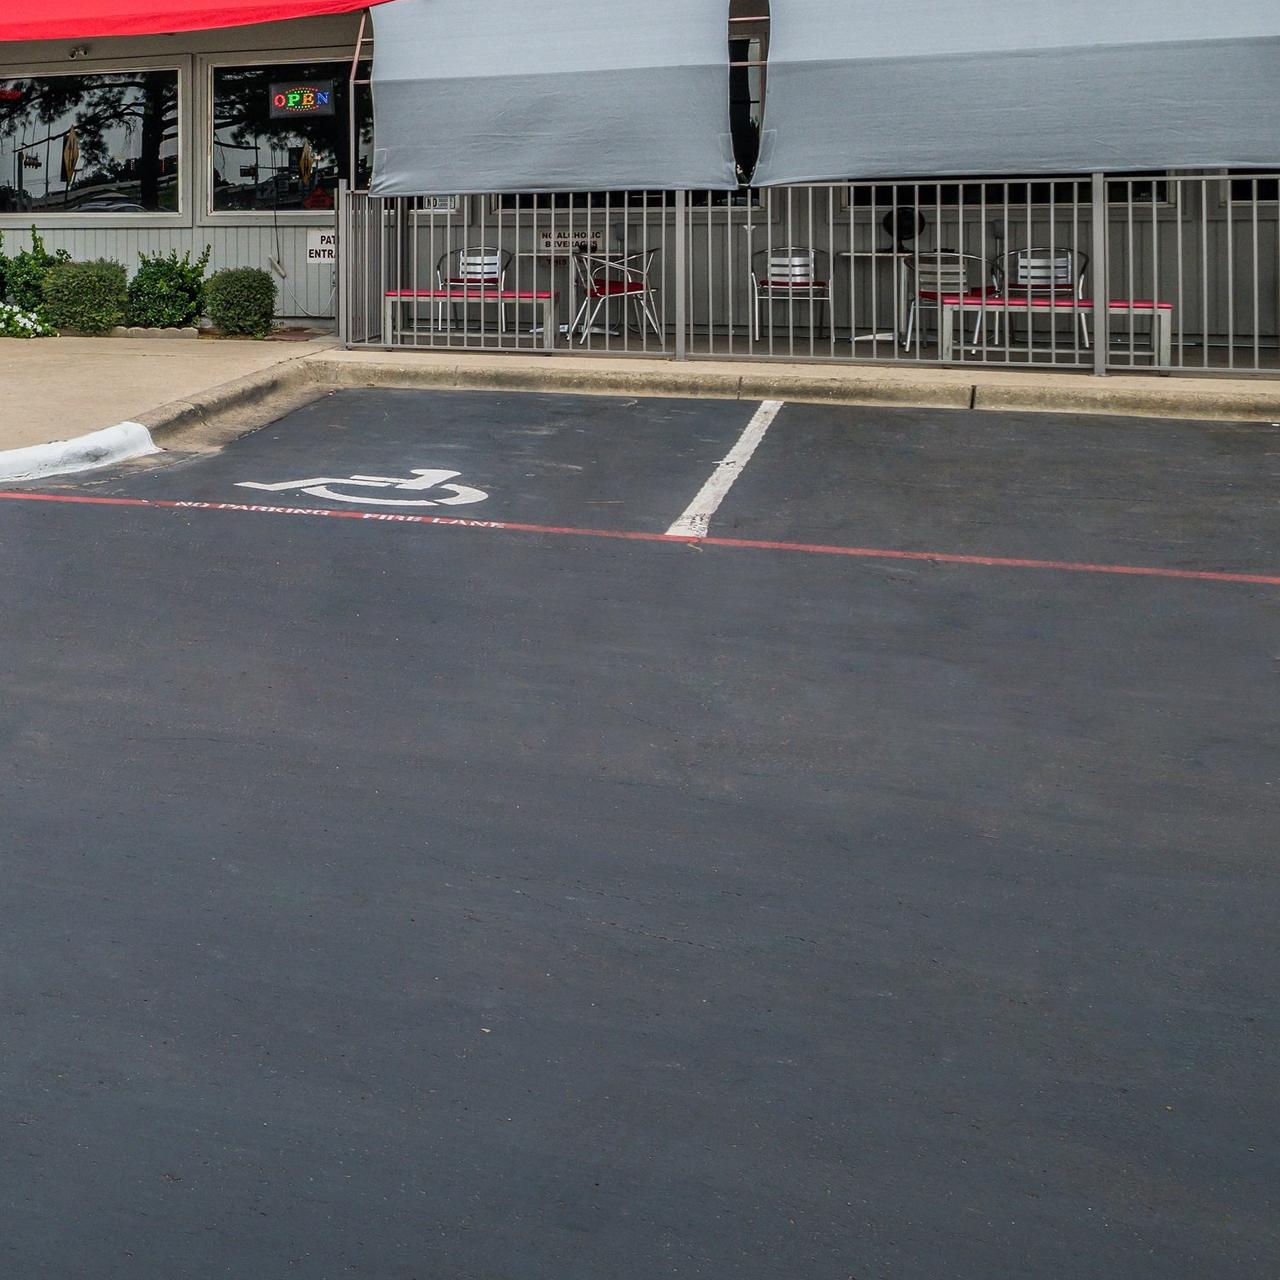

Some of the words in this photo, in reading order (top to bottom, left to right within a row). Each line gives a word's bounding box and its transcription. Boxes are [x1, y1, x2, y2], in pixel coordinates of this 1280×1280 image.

[273, 91, 329, 107] OPEN
[308, 249, 336, 259] ENTR
[218, 503, 331, 516] PARKING
[362, 513, 423, 522] FIRE
[432, 517, 506, 529] LANE
